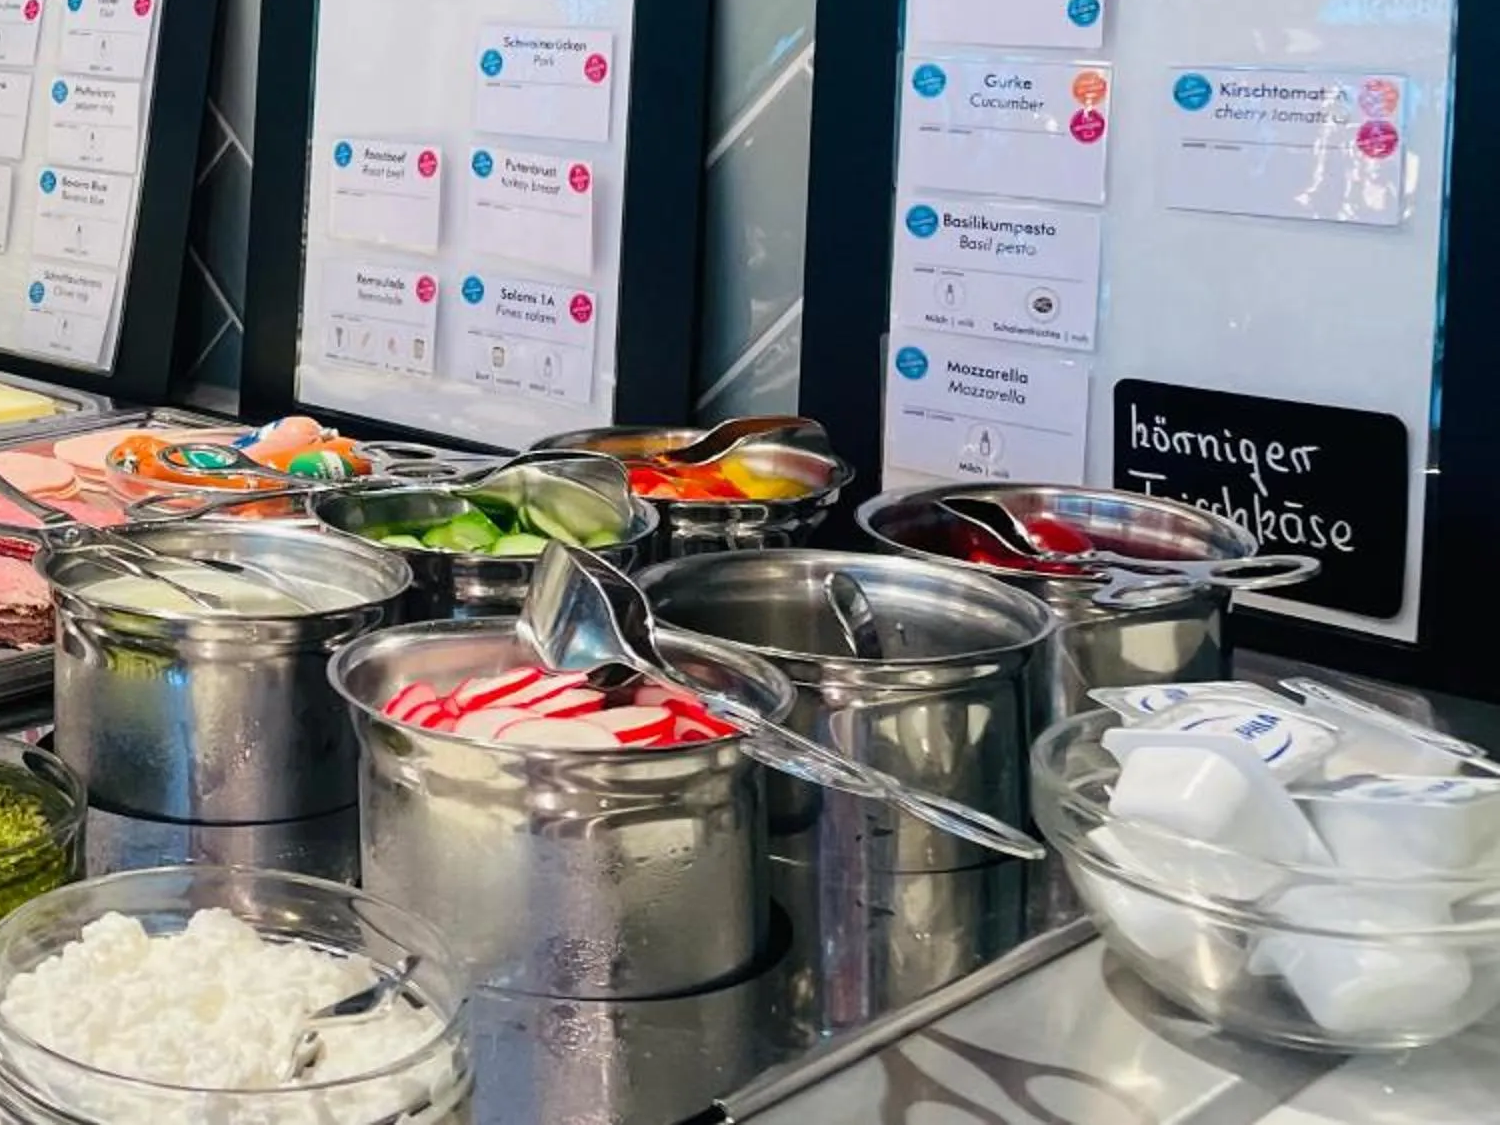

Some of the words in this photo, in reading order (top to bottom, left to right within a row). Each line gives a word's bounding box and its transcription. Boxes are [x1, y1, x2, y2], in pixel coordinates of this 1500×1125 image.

[984, 73, 1033, 90] Gurke
[1219, 81, 1349, 102] Kirschtomatn
[969, 92, 1045, 112] Cucumber
[943, 212, 1058, 236] Basilikumpesto
[959, 234, 993, 251] Basil
[995, 240, 1038, 257] pesto
[947, 359, 1029, 385] Mozzarella
[947, 379, 1027, 406] Mozzarella
[1130, 402, 1322, 498] körniger
